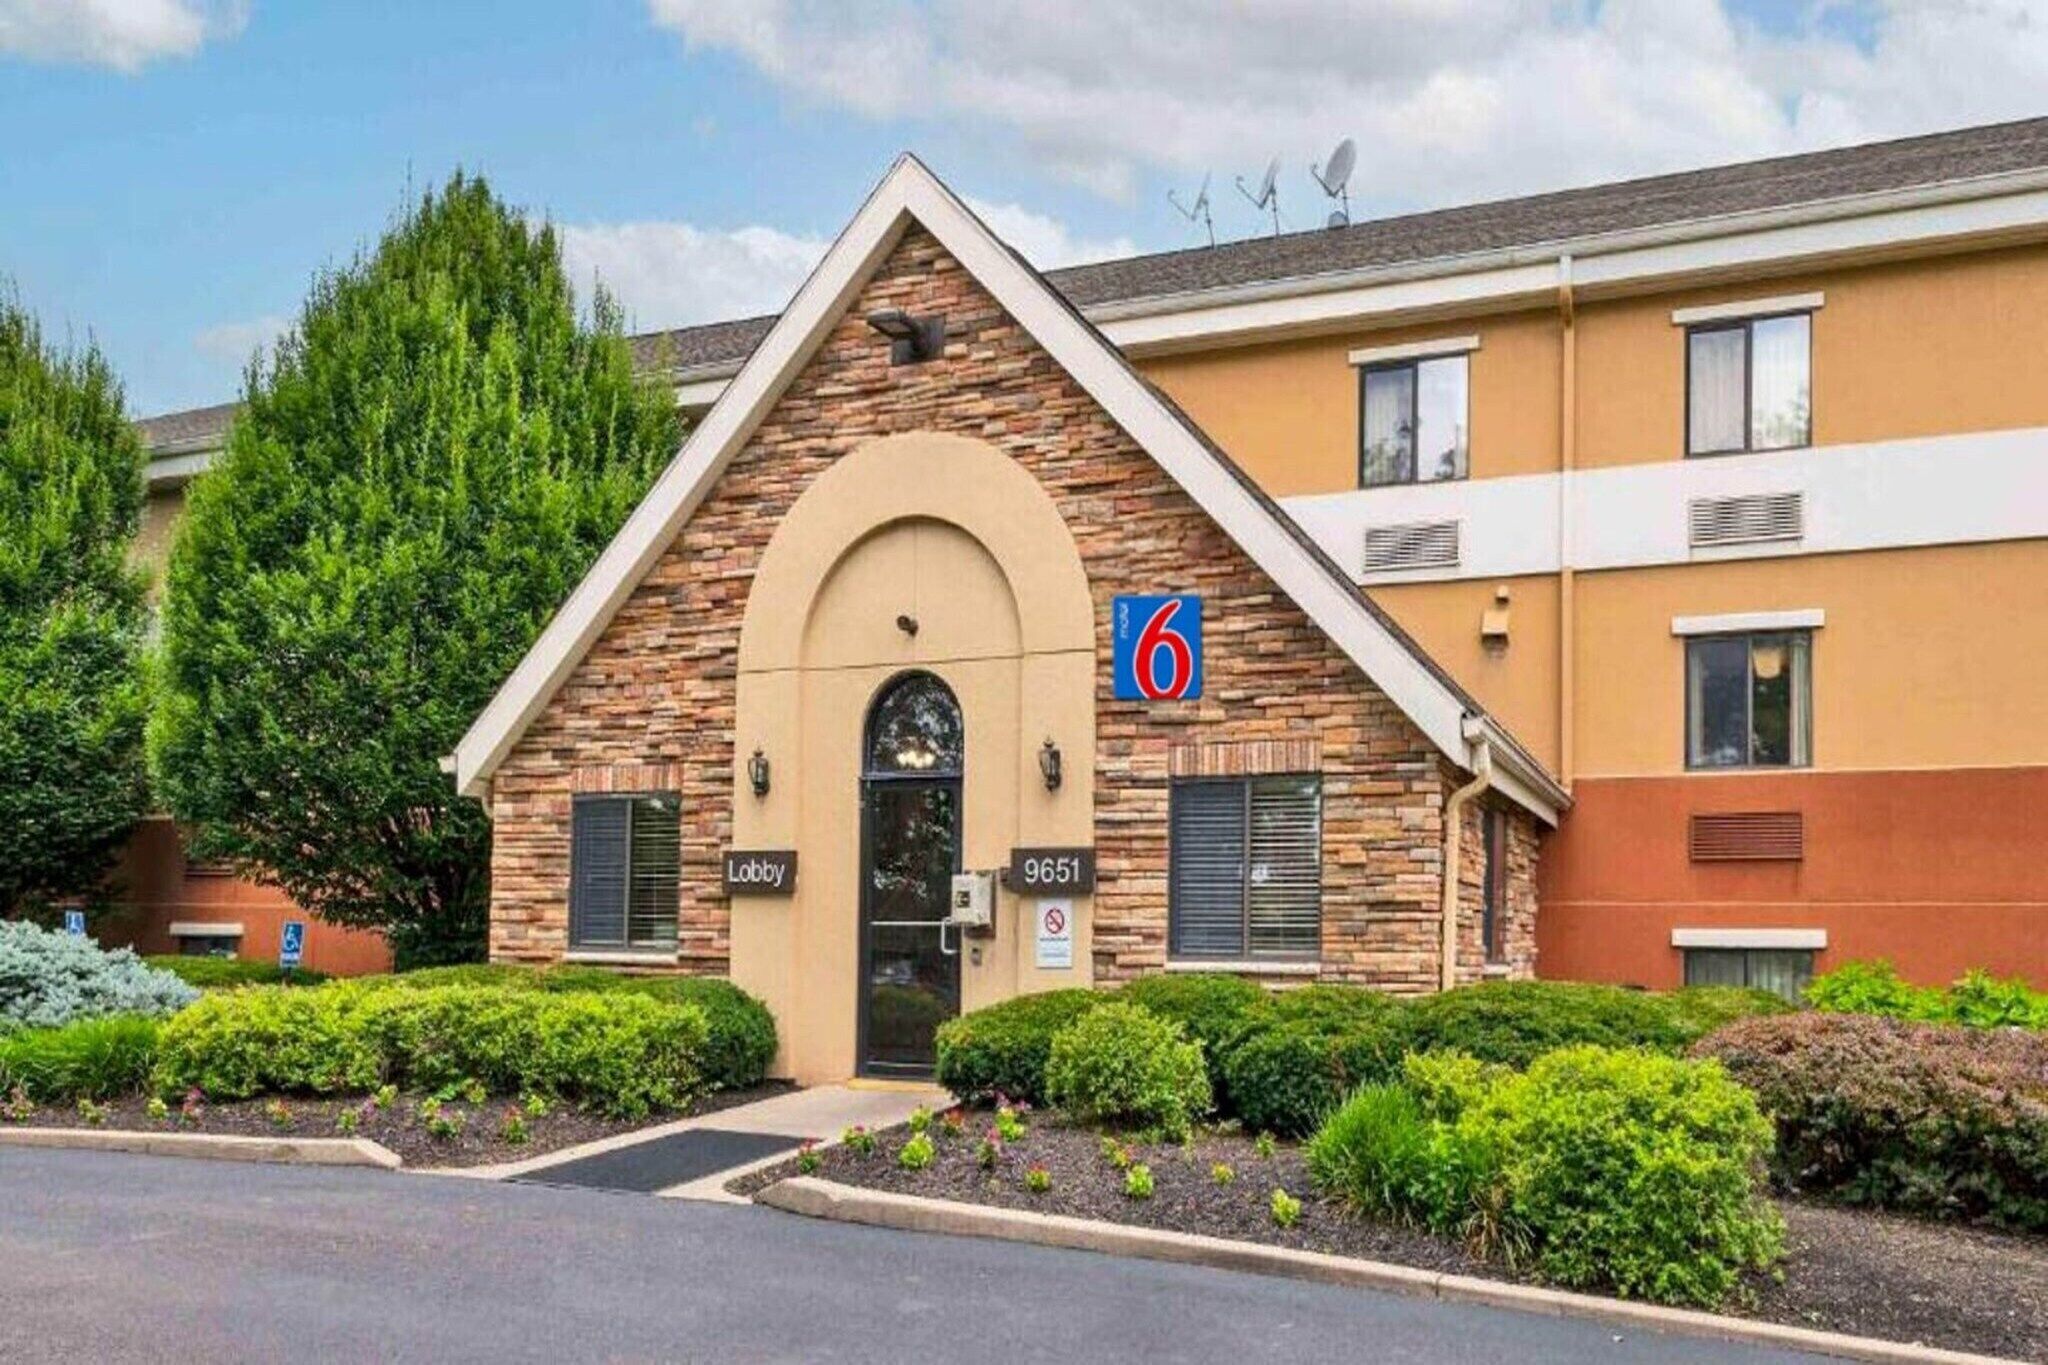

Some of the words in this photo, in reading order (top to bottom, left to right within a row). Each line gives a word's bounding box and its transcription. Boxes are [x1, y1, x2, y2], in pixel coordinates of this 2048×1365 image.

[1132, 598, 1193, 700] 6
[728, 858, 785, 887] Lobby
[1023, 857, 1081, 883] 9651
